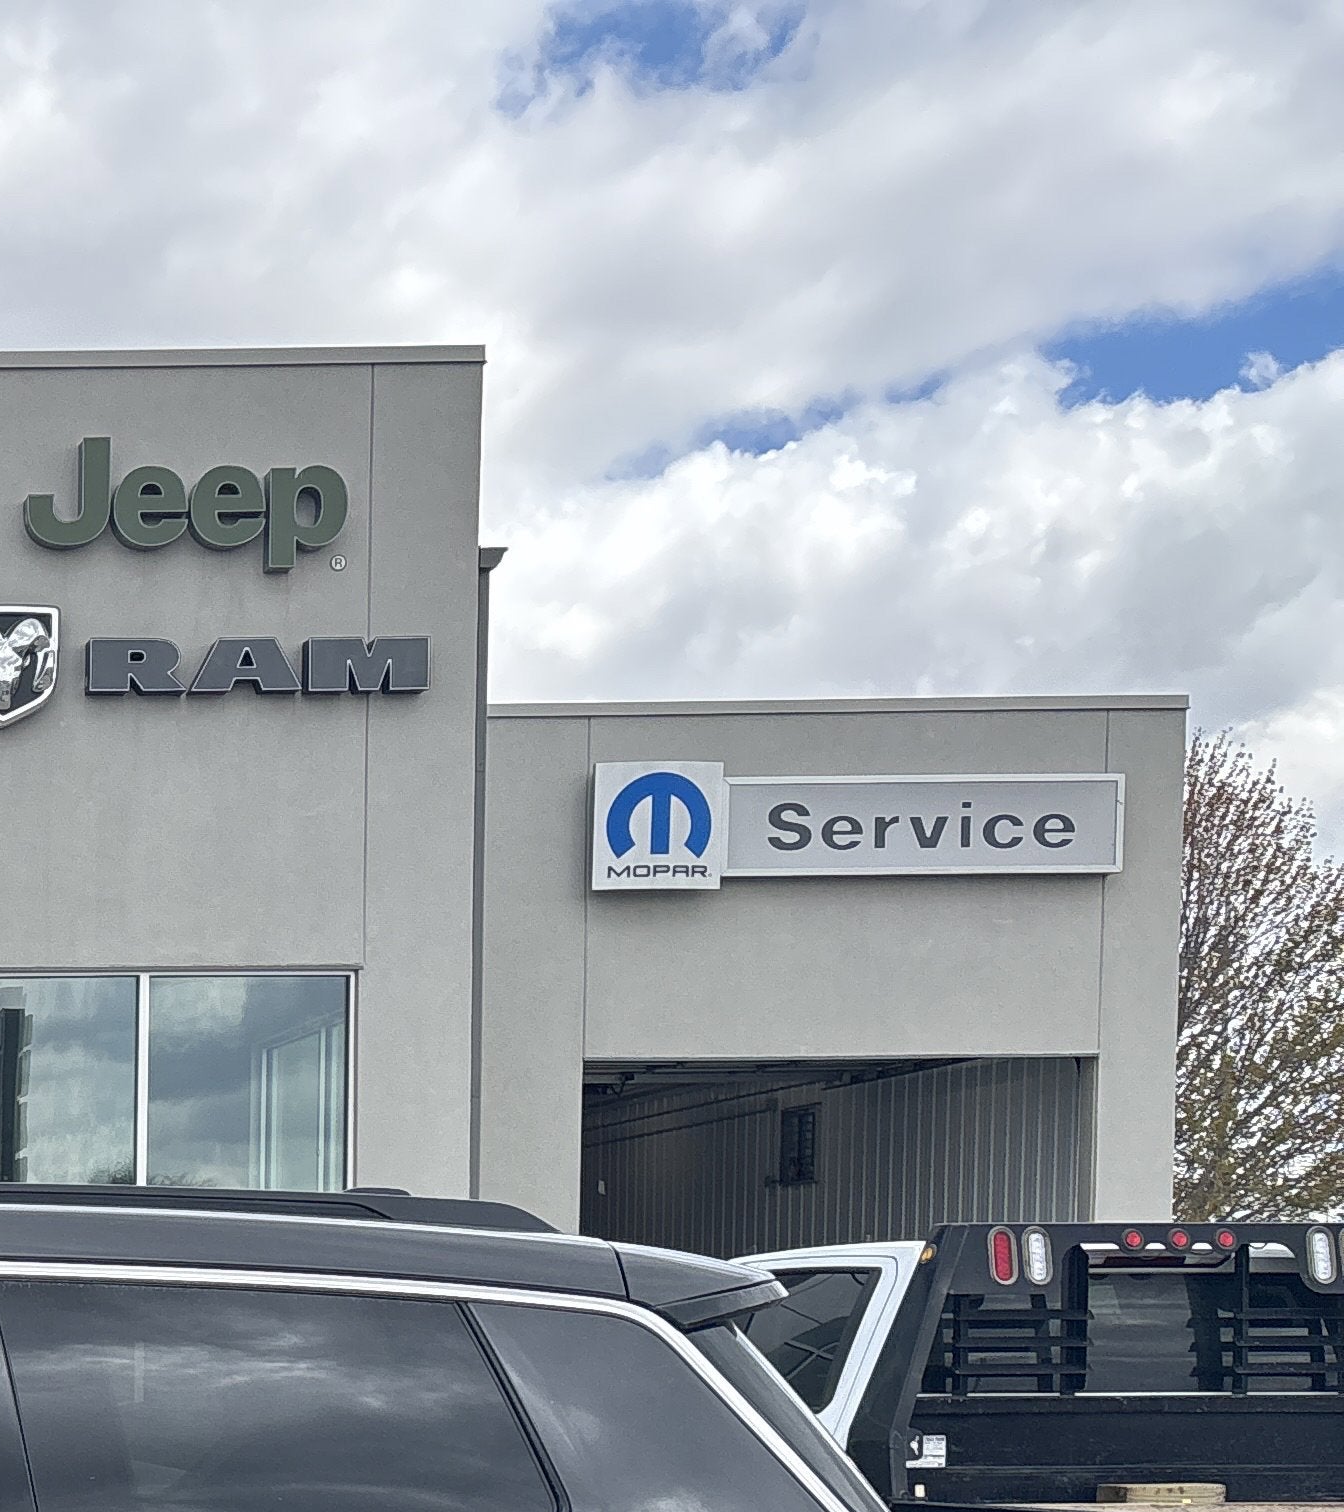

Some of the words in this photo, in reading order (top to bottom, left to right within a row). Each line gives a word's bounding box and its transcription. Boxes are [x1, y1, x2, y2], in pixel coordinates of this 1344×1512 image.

[23, 436, 349, 573] Jeep
[85, 635, 432, 697] RAM
[767, 801, 1076, 852] Service
[607, 864, 709, 879] MOPAR
